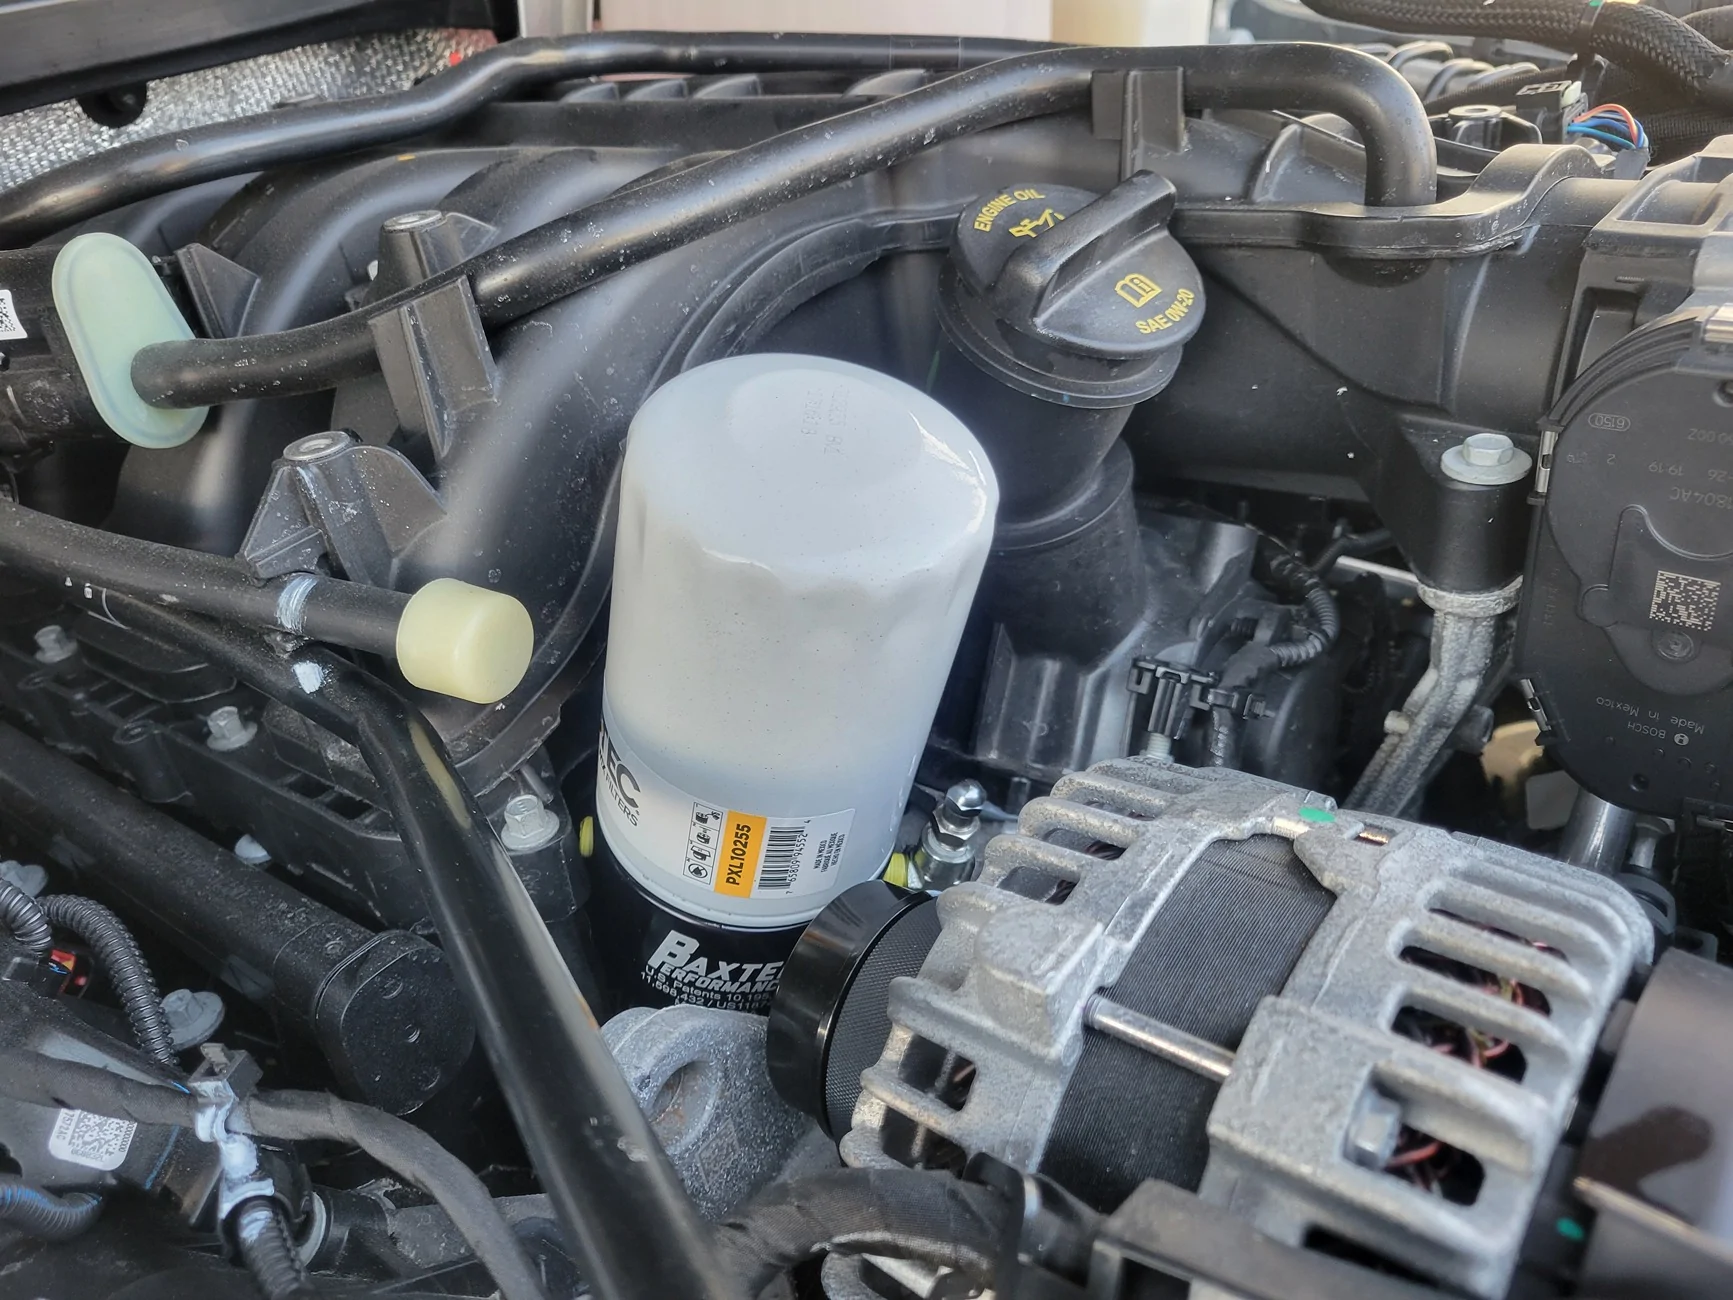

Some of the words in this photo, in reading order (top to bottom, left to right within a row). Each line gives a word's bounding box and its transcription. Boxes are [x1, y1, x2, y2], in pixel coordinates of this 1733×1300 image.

[974, 193, 1014, 232] ENGINE
[1013, 188, 1046, 202] OIL
[1135, 316, 1171, 335] SAE
[1596, 696, 1640, 717] Mexico
[1648, 710, 1660, 721] in
[1627, 721, 1667, 739] BOSCH
[1670, 716, 1705, 734] Made
[605, 773, 638, 826] FILTERS
[726, 823, 752, 886] PXL10255
[648, 930, 785, 982] BAXTE
[645, 965, 669, 985] U.S.
[673, 980, 721, 1000] Patents
